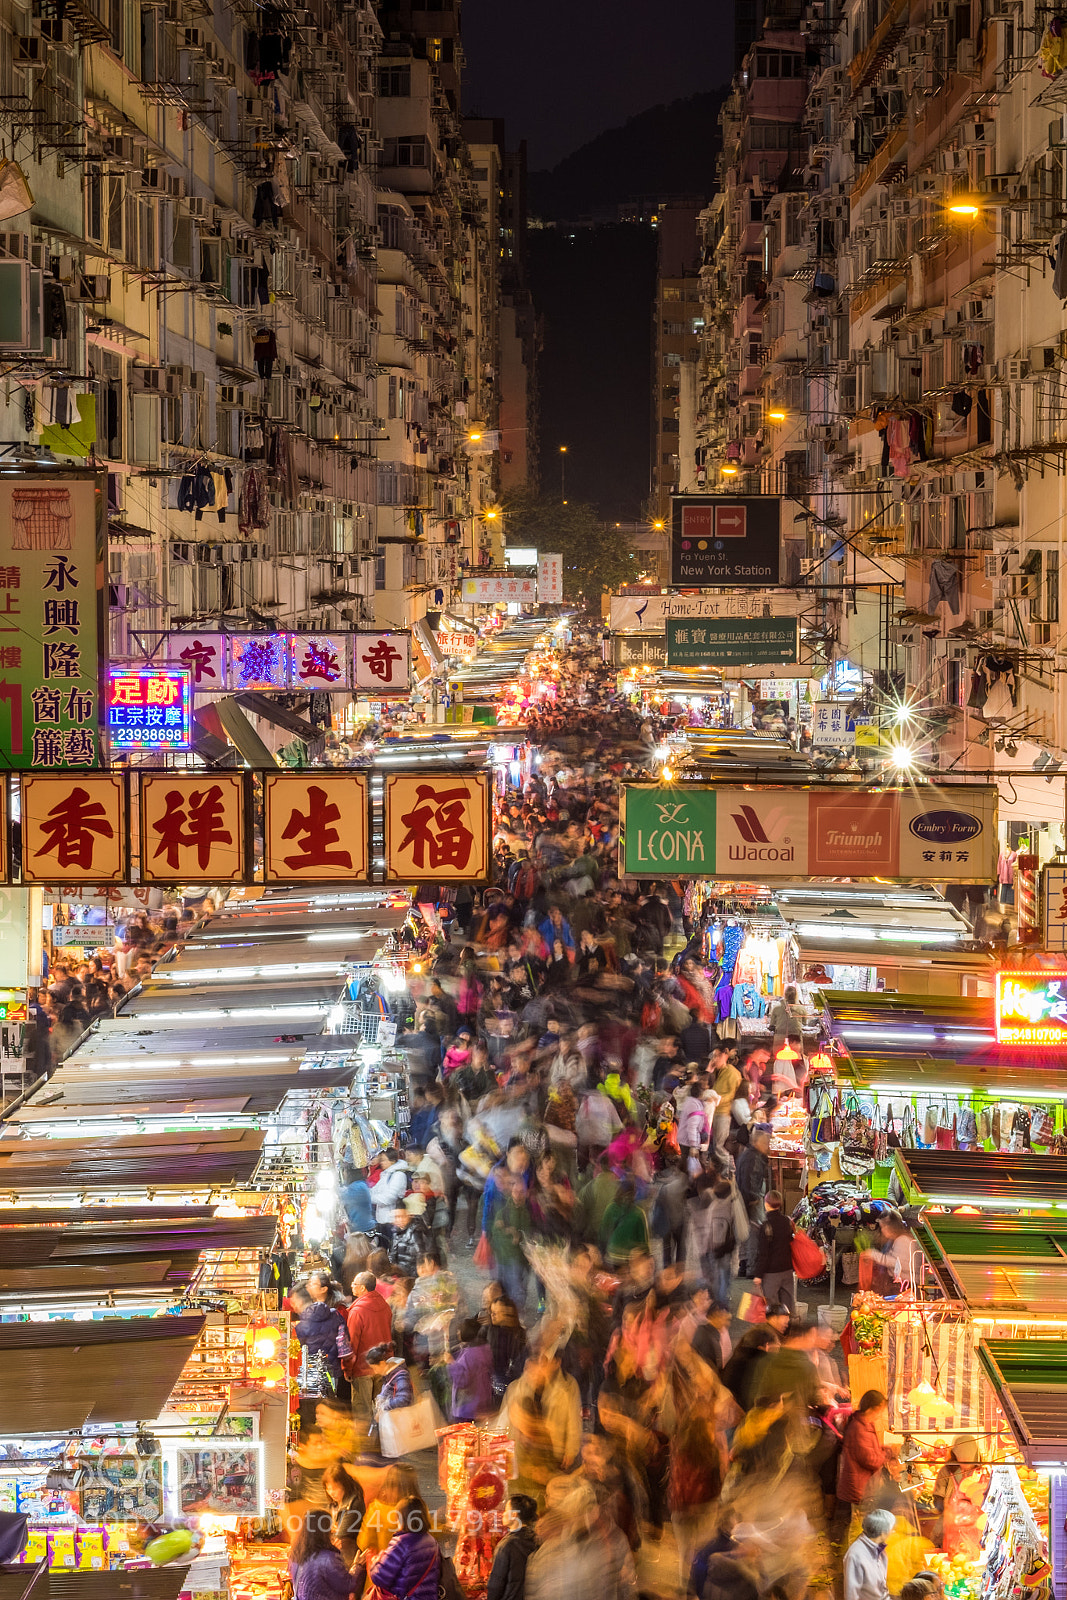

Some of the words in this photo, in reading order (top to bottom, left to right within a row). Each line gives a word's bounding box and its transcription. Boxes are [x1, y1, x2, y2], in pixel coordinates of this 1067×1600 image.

[684, 515, 711, 525] ENTRY
[680, 553, 691, 562] Fa
[693, 553, 716, 562] Yuen
[717, 553, 728, 562] St.
[680, 565, 704, 576] New
[706, 565, 732, 576] York
[734, 565, 772, 576] Station
[660, 597, 721, 616] Home-Text
[41, 555, 80, 680] 永興隆
[439, 645, 472, 656] Suitcase
[110, 677, 180, 706] 足跡
[109, 705, 184, 726] 正宗按摩
[62, 686, 94, 766] 布藝
[915, 822, 947, 835] Embry
[951, 823, 977, 835] Form
[637, 829, 706, 862] LEONA
[825, 829, 884, 848] Triumph
[728, 844, 795, 862] Wacoal
[921, 850, 970, 863] 安莉芳
